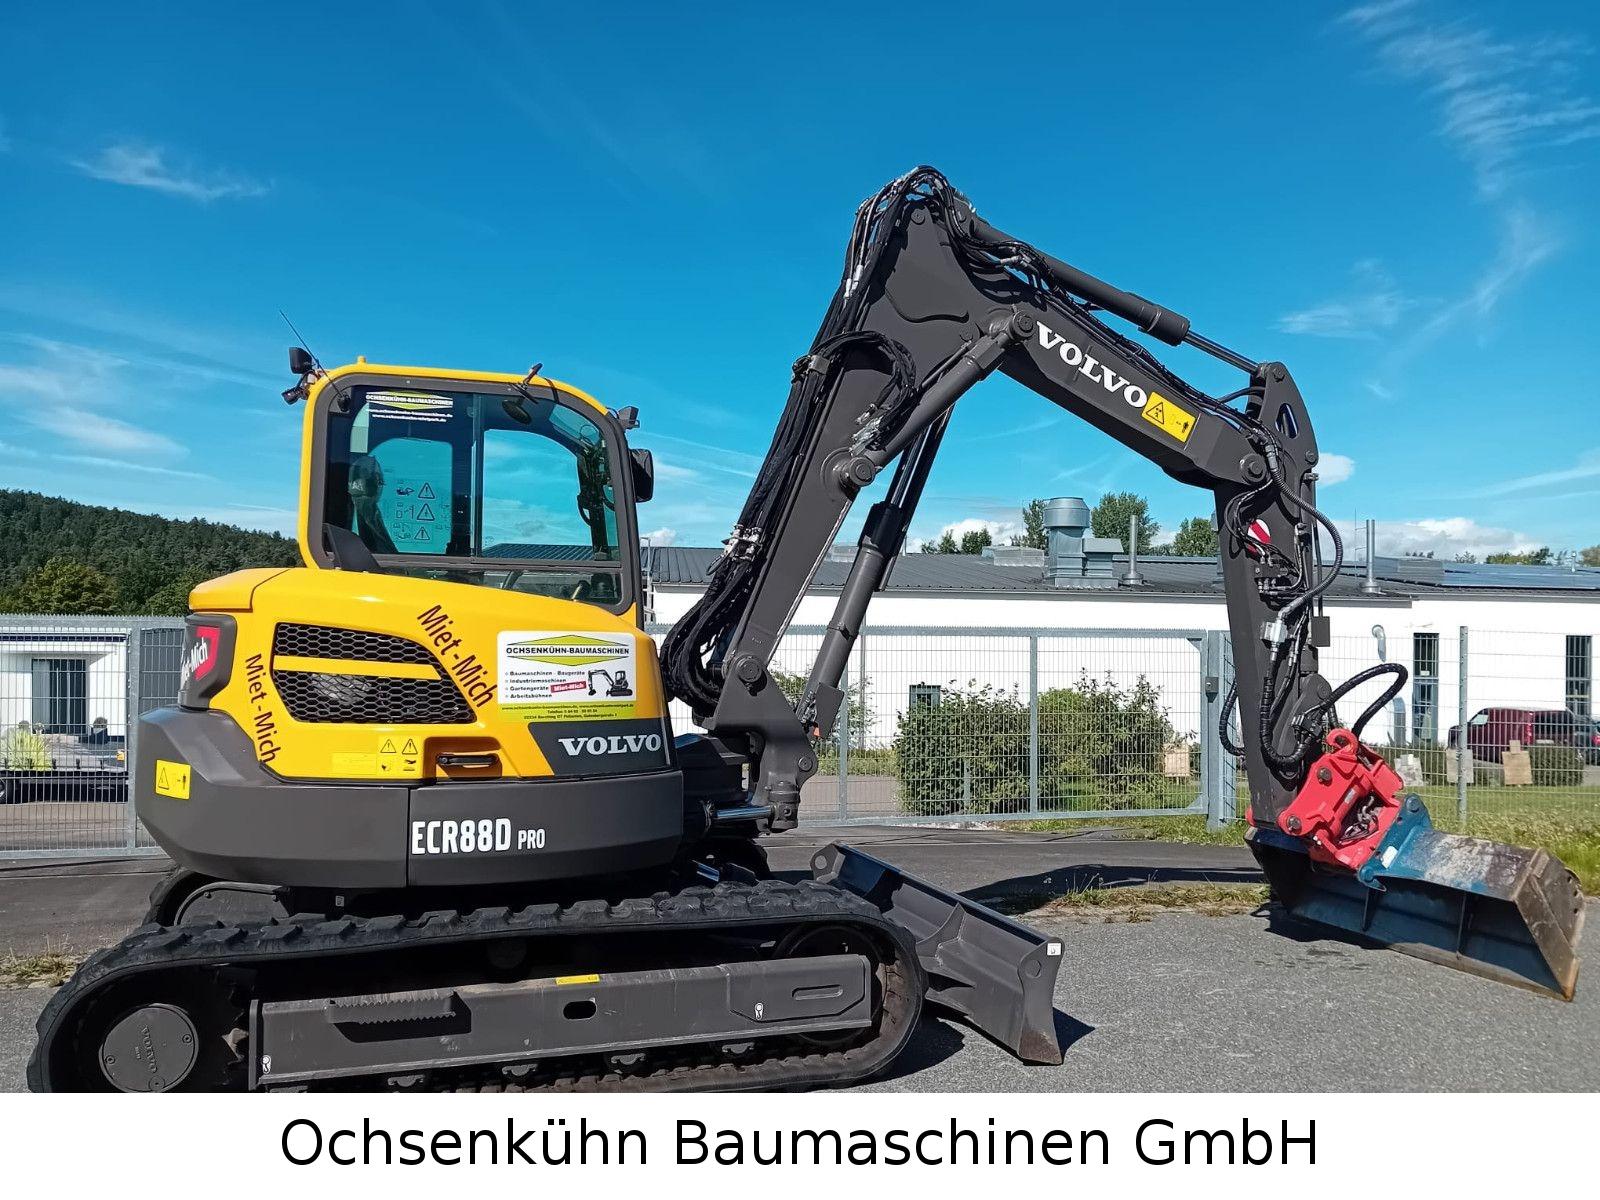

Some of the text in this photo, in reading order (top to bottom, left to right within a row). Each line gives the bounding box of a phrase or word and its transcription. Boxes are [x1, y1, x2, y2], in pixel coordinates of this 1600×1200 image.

[1037, 321, 1148, 408] VOLVO
[506, 646, 630, 655] OCHSENKÜHN-BAUMASCHINEN
[558, 734, 661, 756] VOLVO
[412, 818, 545, 854] ECR88D PRO
